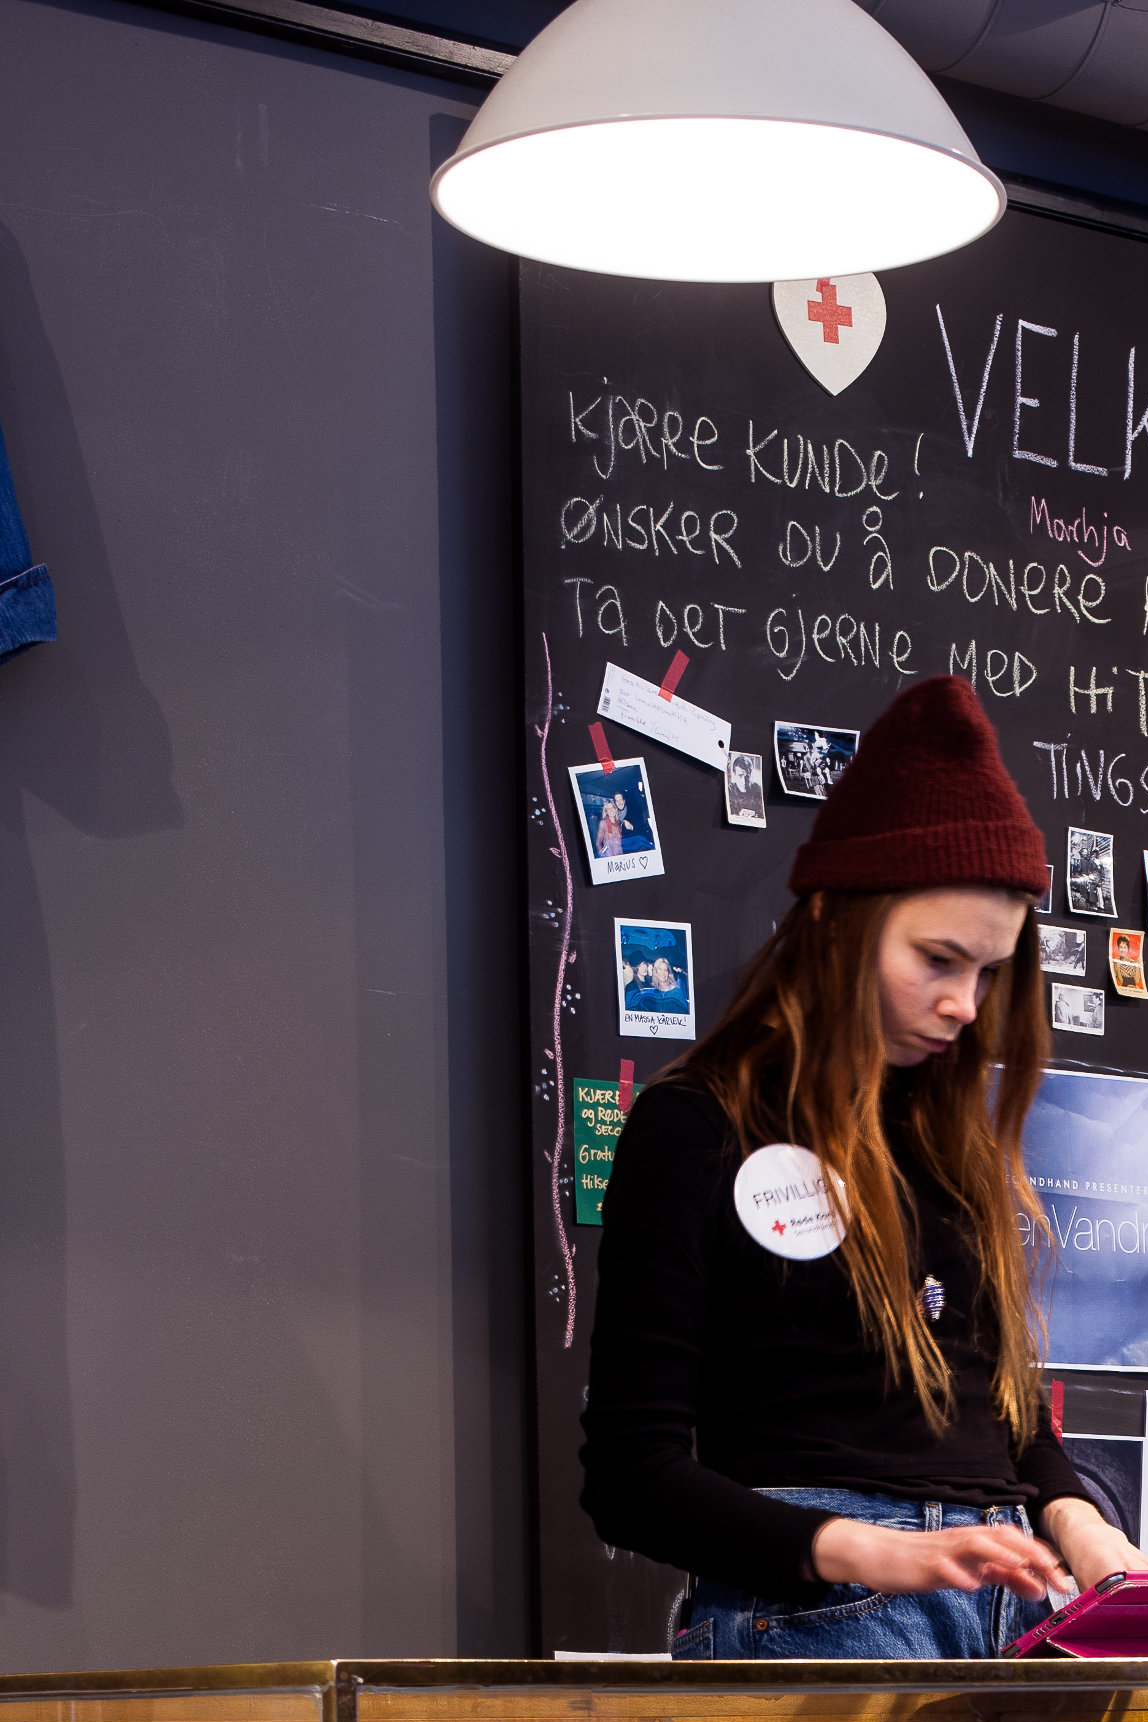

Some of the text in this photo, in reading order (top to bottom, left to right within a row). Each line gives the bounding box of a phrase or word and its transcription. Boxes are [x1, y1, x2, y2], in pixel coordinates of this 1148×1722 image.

[778, 520, 840, 572] DU
[581, 1108, 595, 1127] og
[595, 1124, 623, 1136] SECO
[579, 1144, 615, 1164] Gratu
[582, 1174, 609, 1190] Hilse
